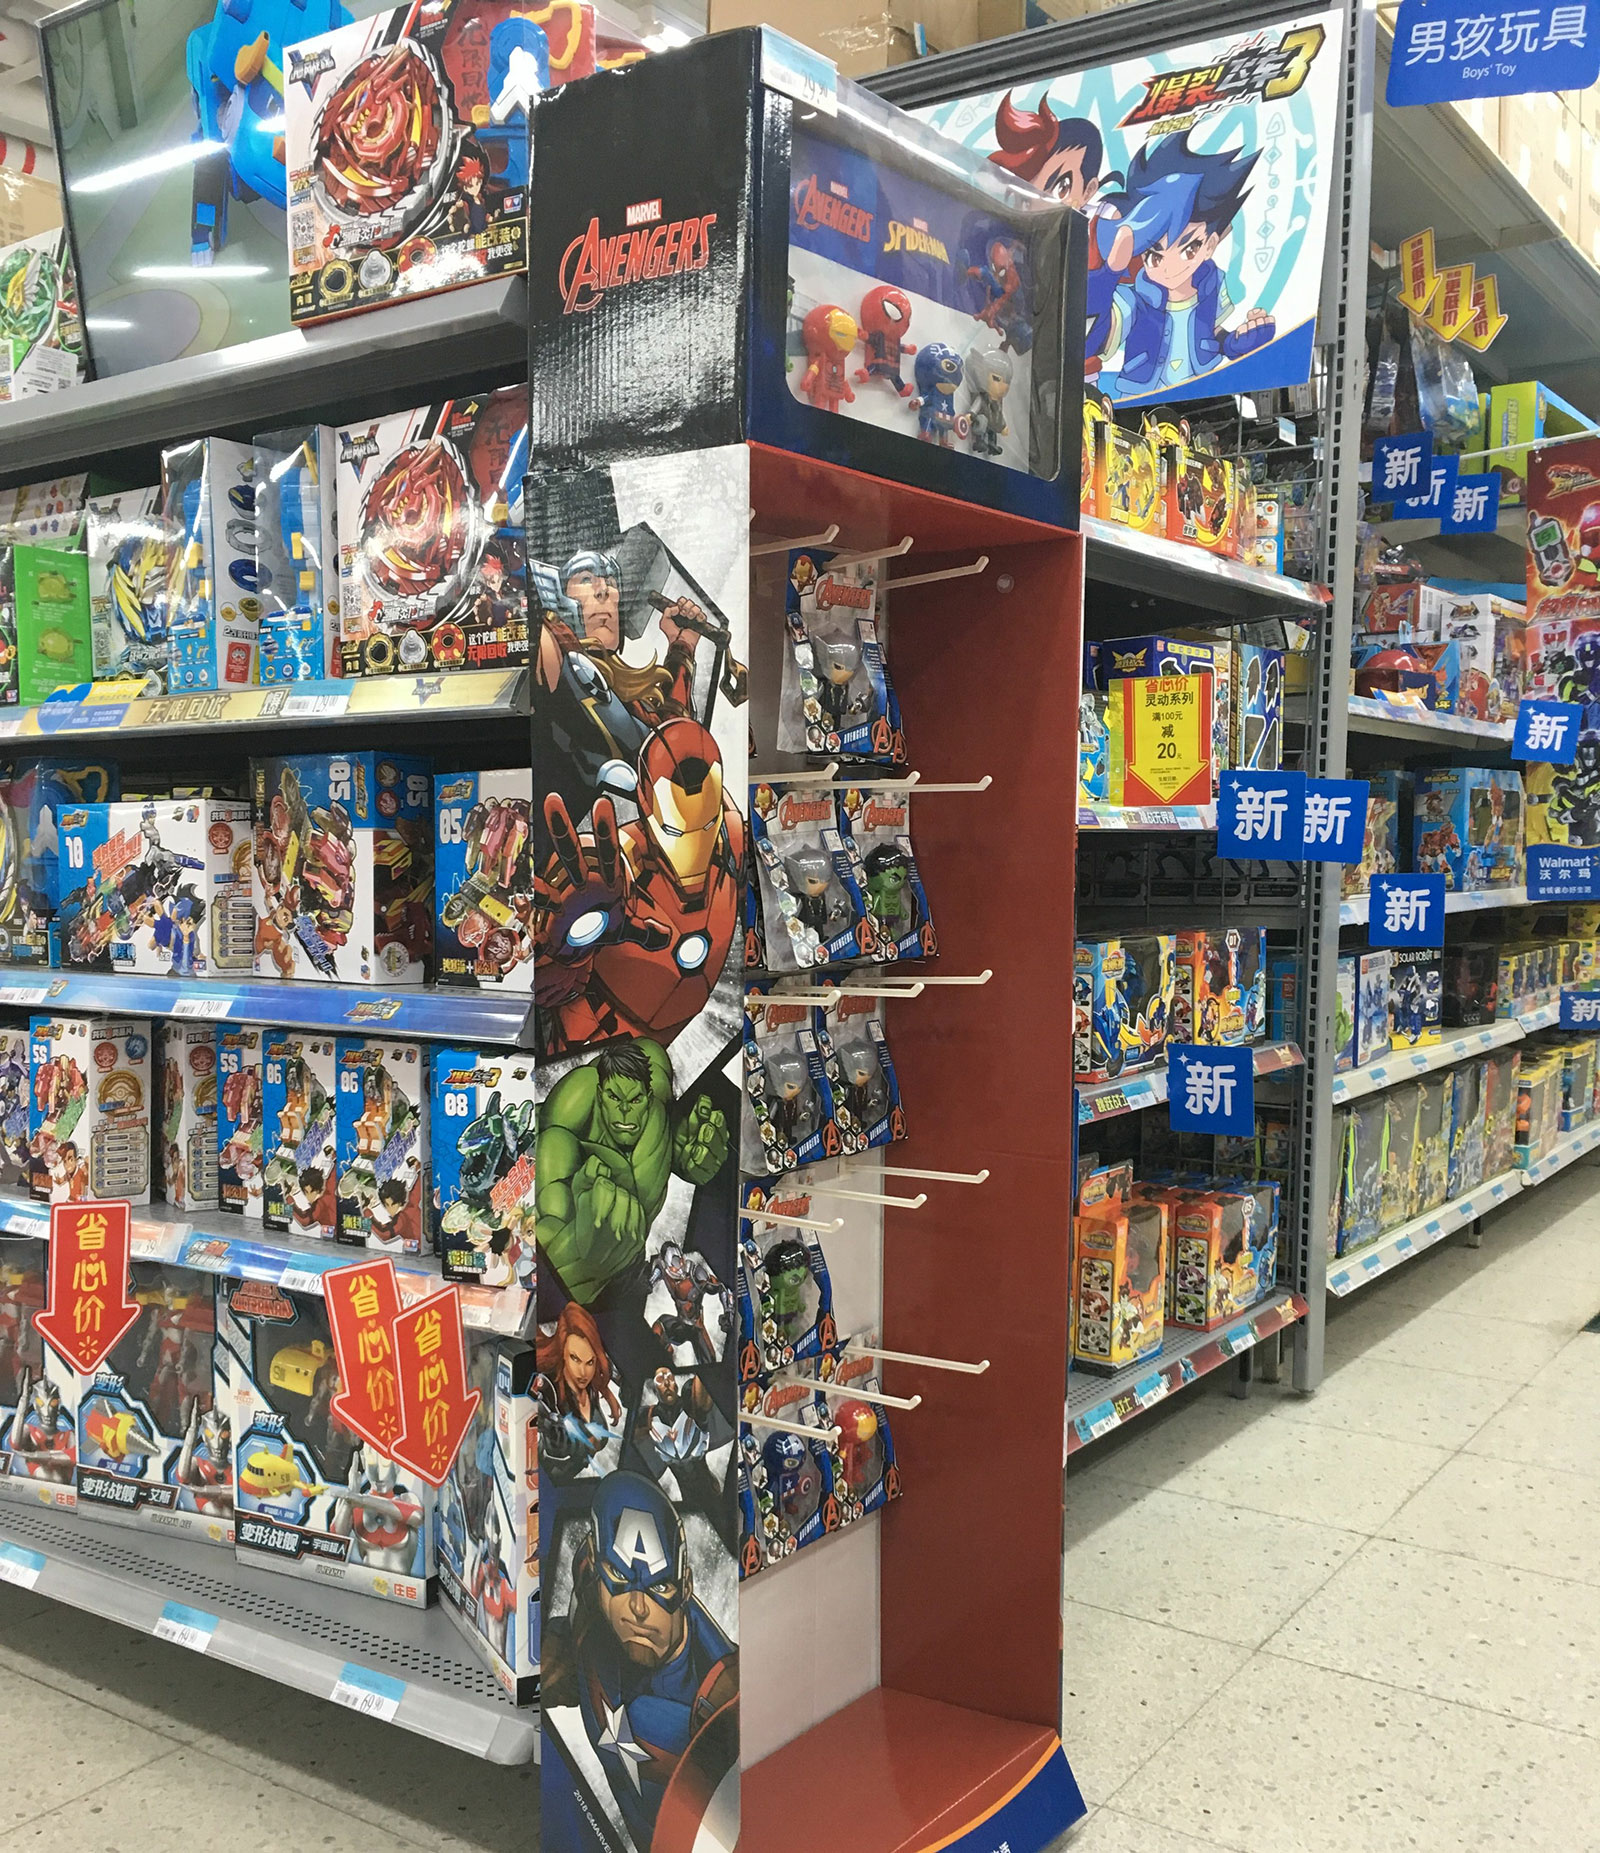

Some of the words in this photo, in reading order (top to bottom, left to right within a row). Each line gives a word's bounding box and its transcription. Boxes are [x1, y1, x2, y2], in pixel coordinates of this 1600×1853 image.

[1404, 5, 1587, 66] 男孩玩具
[1131, 23, 1326, 119] 爆裂飞车3
[1462, 65, 1493, 80] Boys'
[1495, 63, 1517, 77] Toy
[626, 200, 662, 226] MARVEL
[794, 174, 874, 243] AVENGERS
[884, 220, 950, 264] SPIDER-MAN
[558, 213, 718, 315] AVENGERS
[1384, 446, 1422, 489] 新
[1452, 486, 1489, 523] 新
[815, 575, 873, 611] AVENGERS
[1145, 677, 1189, 693] 省心价
[1145, 691, 1194, 707] 灵动系列
[1152, 712, 1183, 721] 满100元
[1161, 724, 1174, 738] 减
[1525, 712, 1569, 751] 新
[439, 808, 464, 844] 05
[779, 795, 832, 831] AVENGERS
[1233, 787, 1289, 841] 新
[1304, 793, 1351, 845] 新
[65, 836, 84, 869] 10
[1539, 855, 1591, 868] Walmart
[1539, 868, 1591, 880] 沃尔玛
[1383, 887, 1431, 932] 新
[1399, 952, 1416, 964] SOLAR
[1416, 950, 1433, 962] ROBOT
[340, 1070, 358, 1094] 06
[1185, 1061, 1237, 1117] 新
[444, 1092, 469, 1117] 08
[73, 1213, 108, 1335] 省心价
[349, 1274, 395, 1413] 省心价
[95, 1373, 125, 1393] 变形
[414, 1309, 452, 1446] 省心价
[253, 1412, 285, 1434] 变形
[56, 1492, 76, 1507] 庄臣
[81, 1476, 137, 1503] 变形战舰
[148, 1487, 172, 1504] 艾斯
[239, 1523, 299, 1553] 变形战舰
[312, 1538, 346, 1557] 宇宙超人
[613, 1507, 668, 1575] A
[393, 1583, 418, 1600] 庄臣
[573, 1789, 588, 1812] 2018
